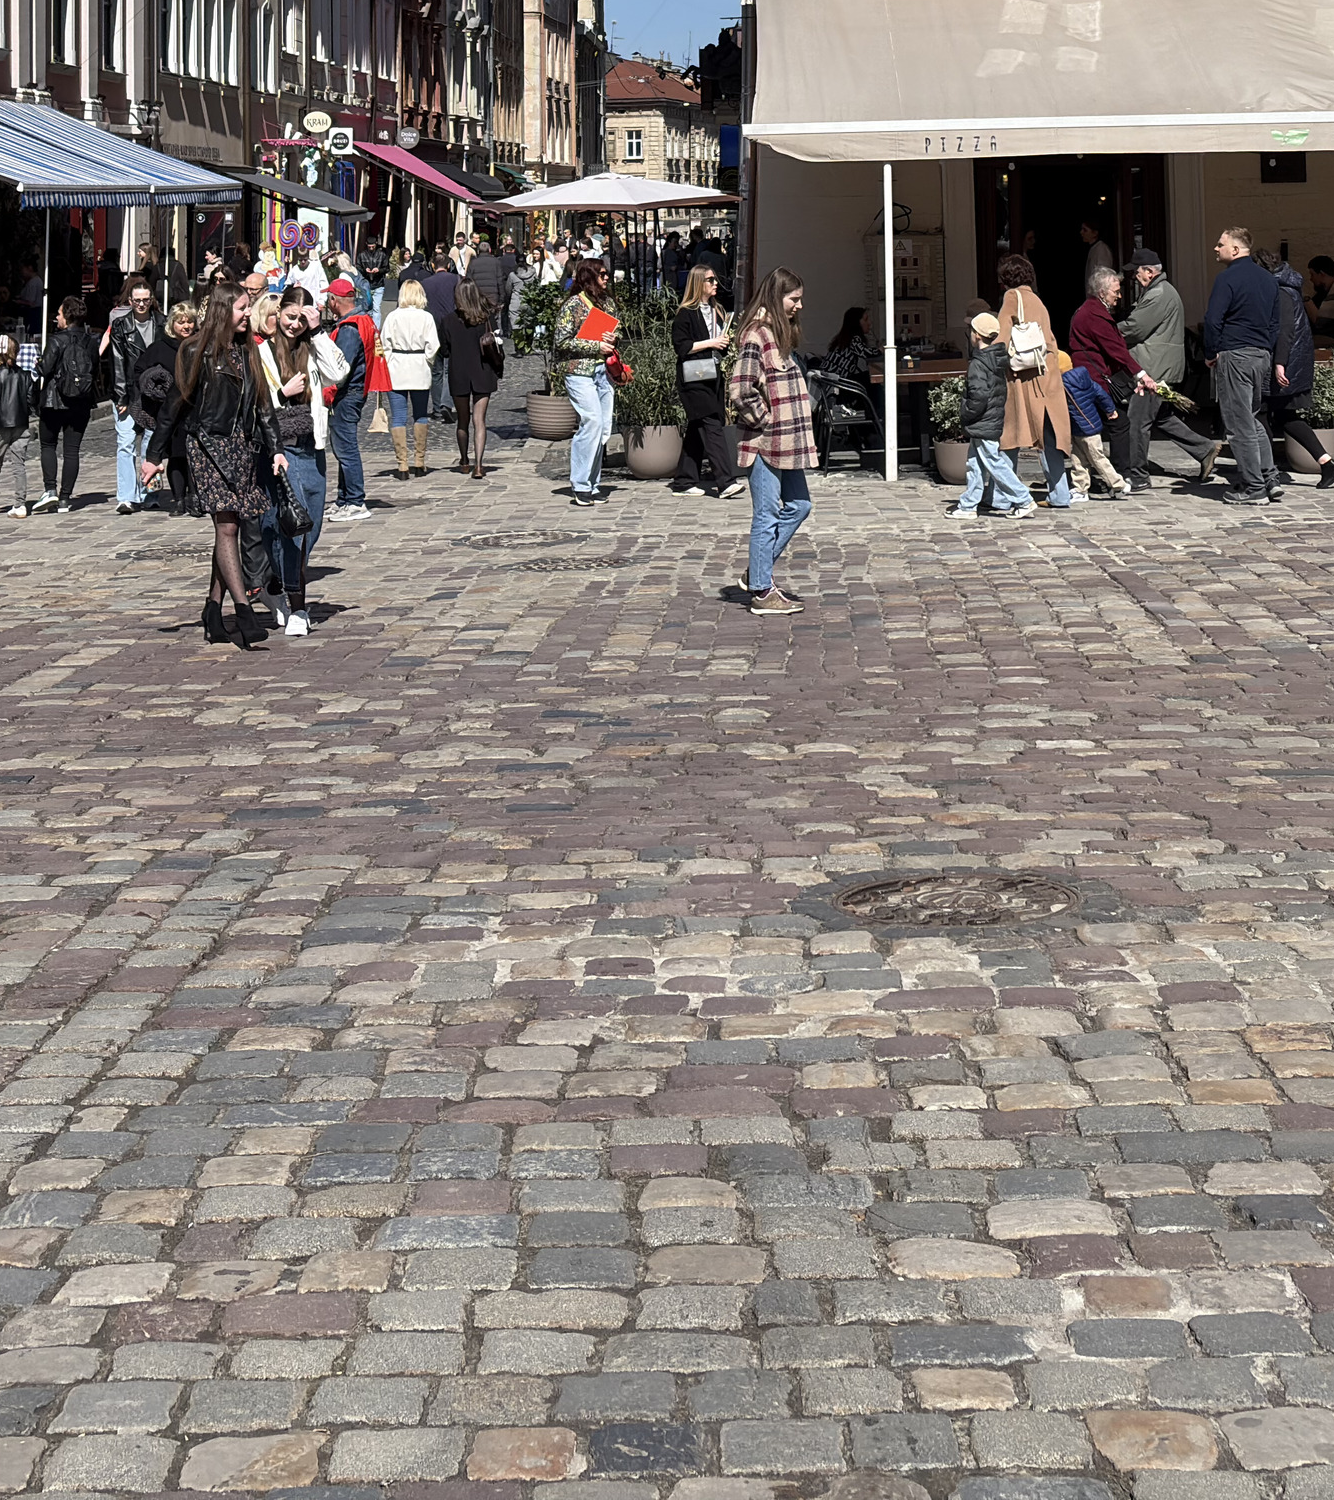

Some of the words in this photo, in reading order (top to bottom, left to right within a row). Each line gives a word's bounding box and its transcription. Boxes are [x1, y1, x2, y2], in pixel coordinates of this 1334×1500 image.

[306, 118, 328, 128] KRAM
[400, 130, 417, 138] Dolce
[924, 135, 997, 154] PIZZA
